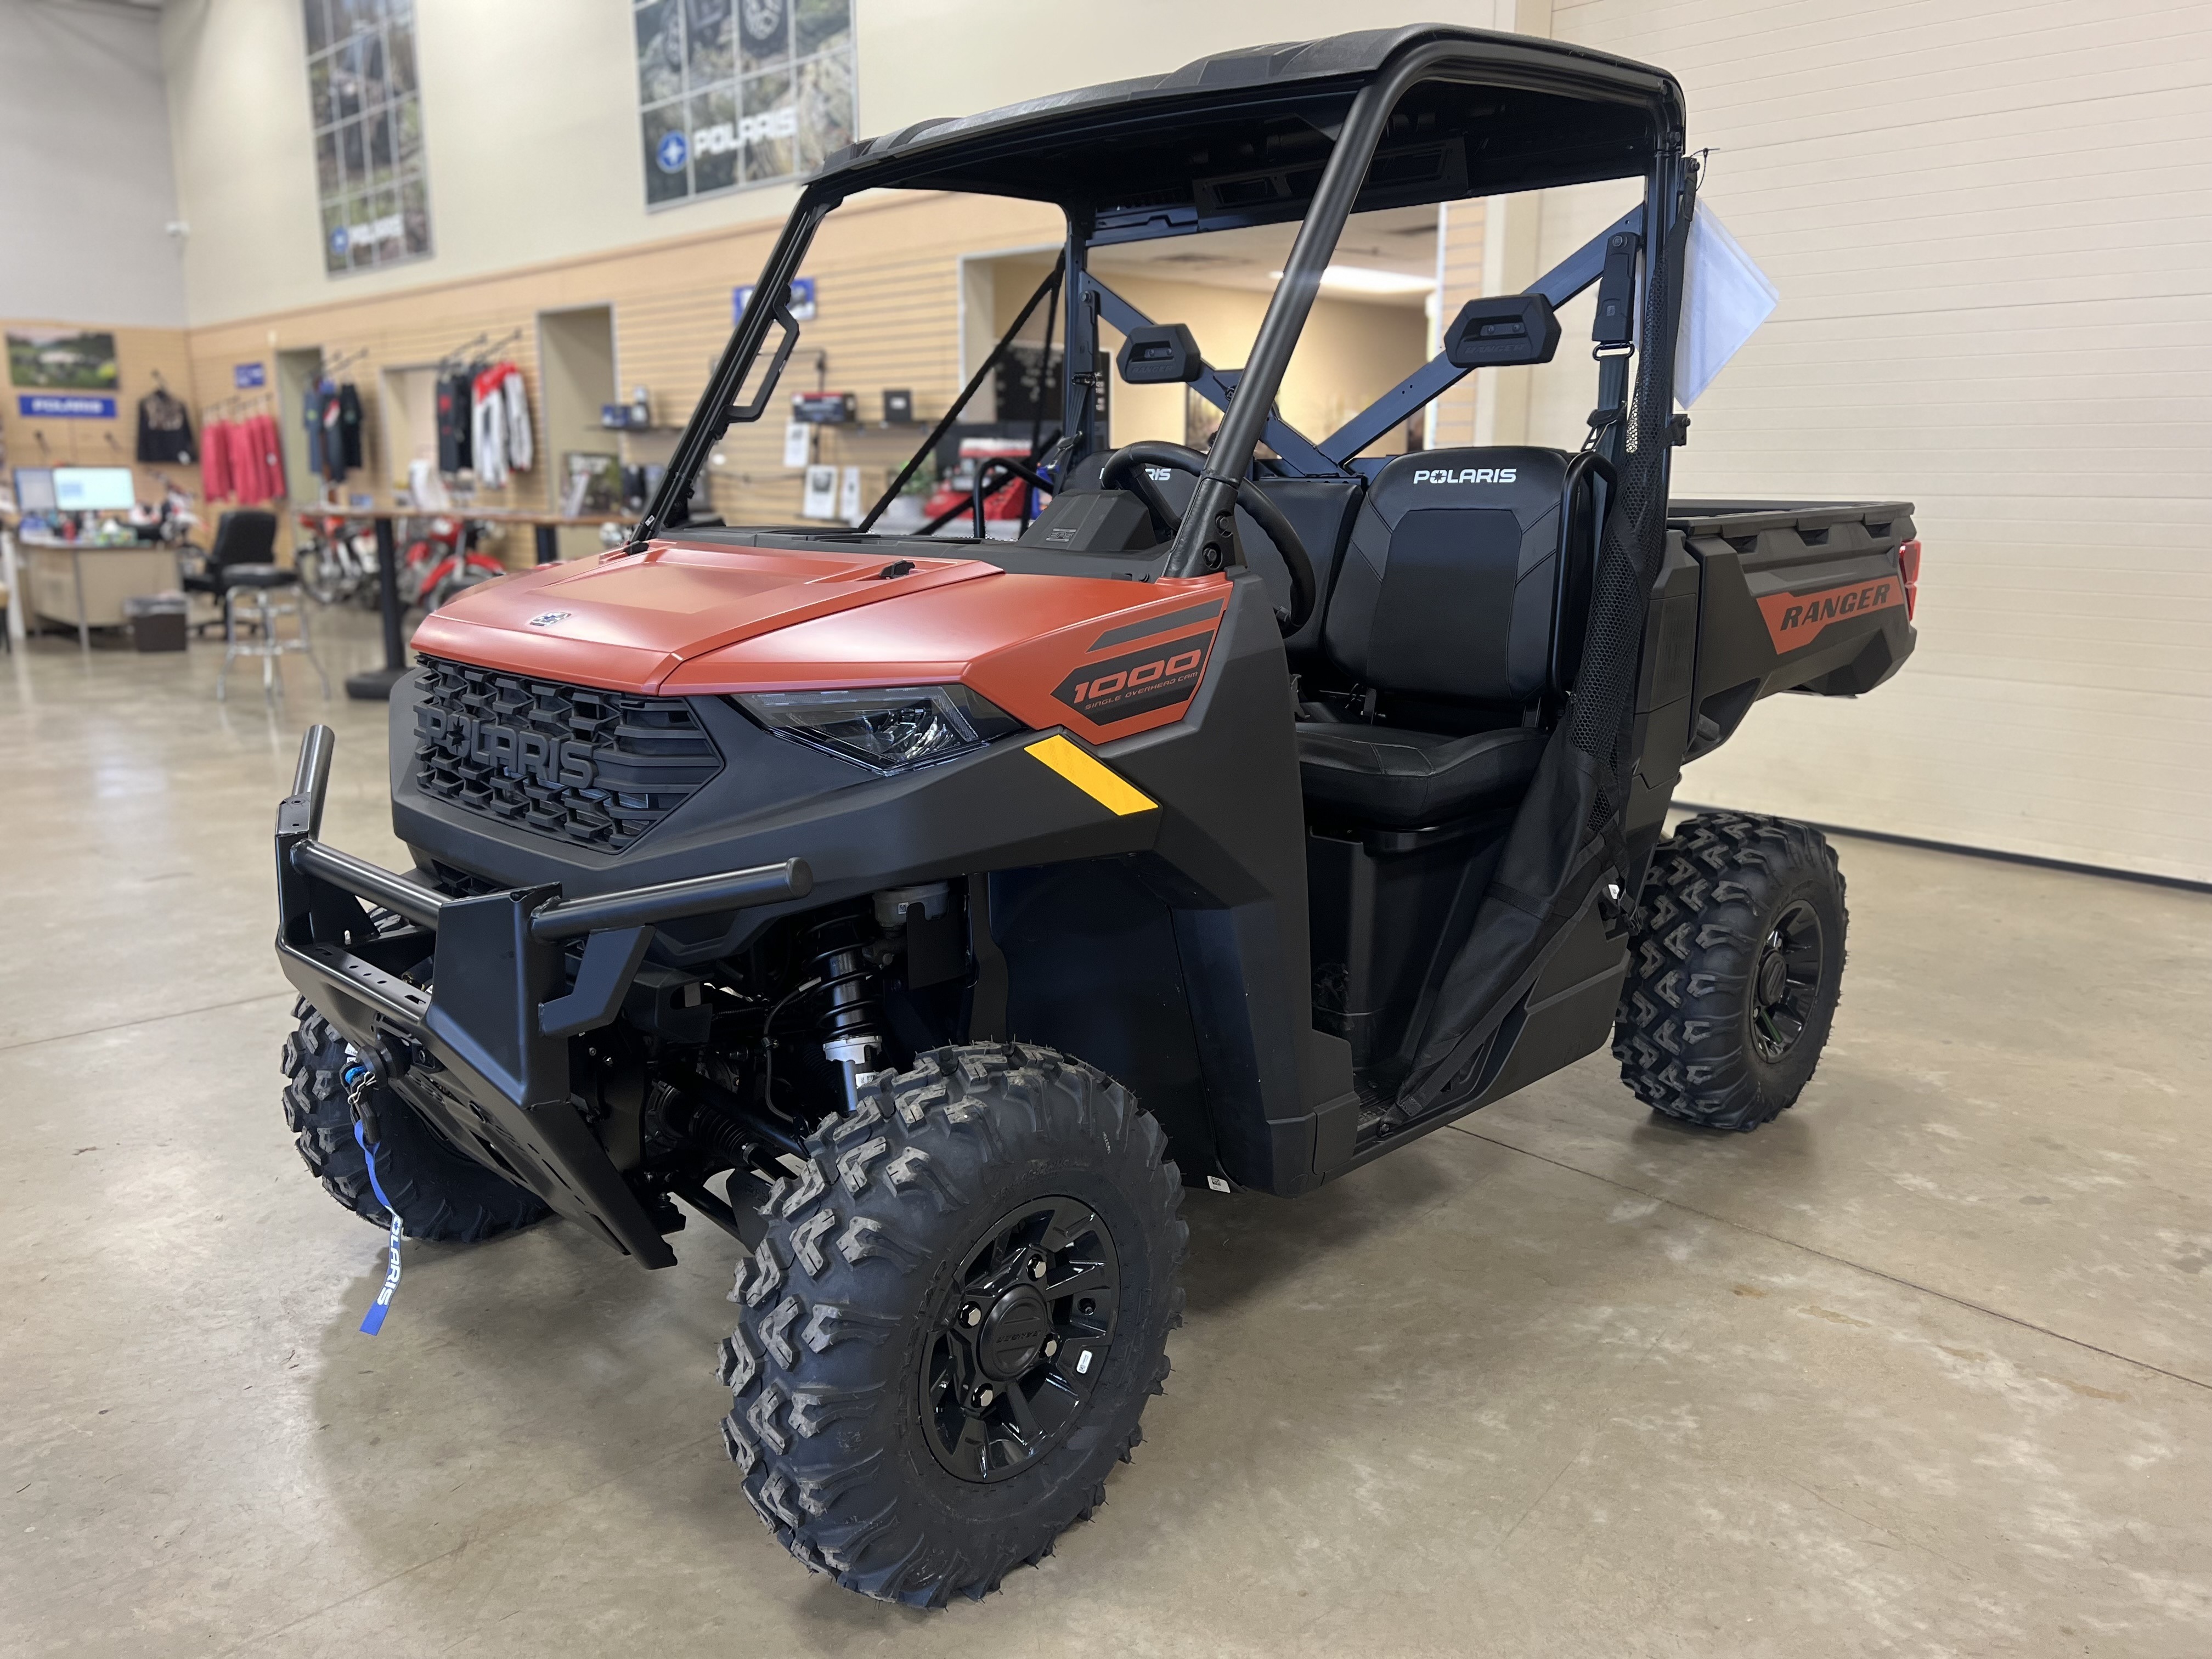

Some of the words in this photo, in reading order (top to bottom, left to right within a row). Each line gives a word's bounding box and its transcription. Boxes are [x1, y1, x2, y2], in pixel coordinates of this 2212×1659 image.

[693, 105, 797, 160] POLARIS
[1413, 468, 1517, 484] POLARIS
[1780, 583, 1891, 631] RANGER
[1074, 649, 1201, 704] 1000
[1085, 695, 1121, 710] SINGLE
[1125, 678, 1176, 698] OVERHEAD
[1177, 672, 1198, 682] CAM
[424, 704, 599, 789] POLARIS
[377, 1205, 402, 1306] OLARIS
